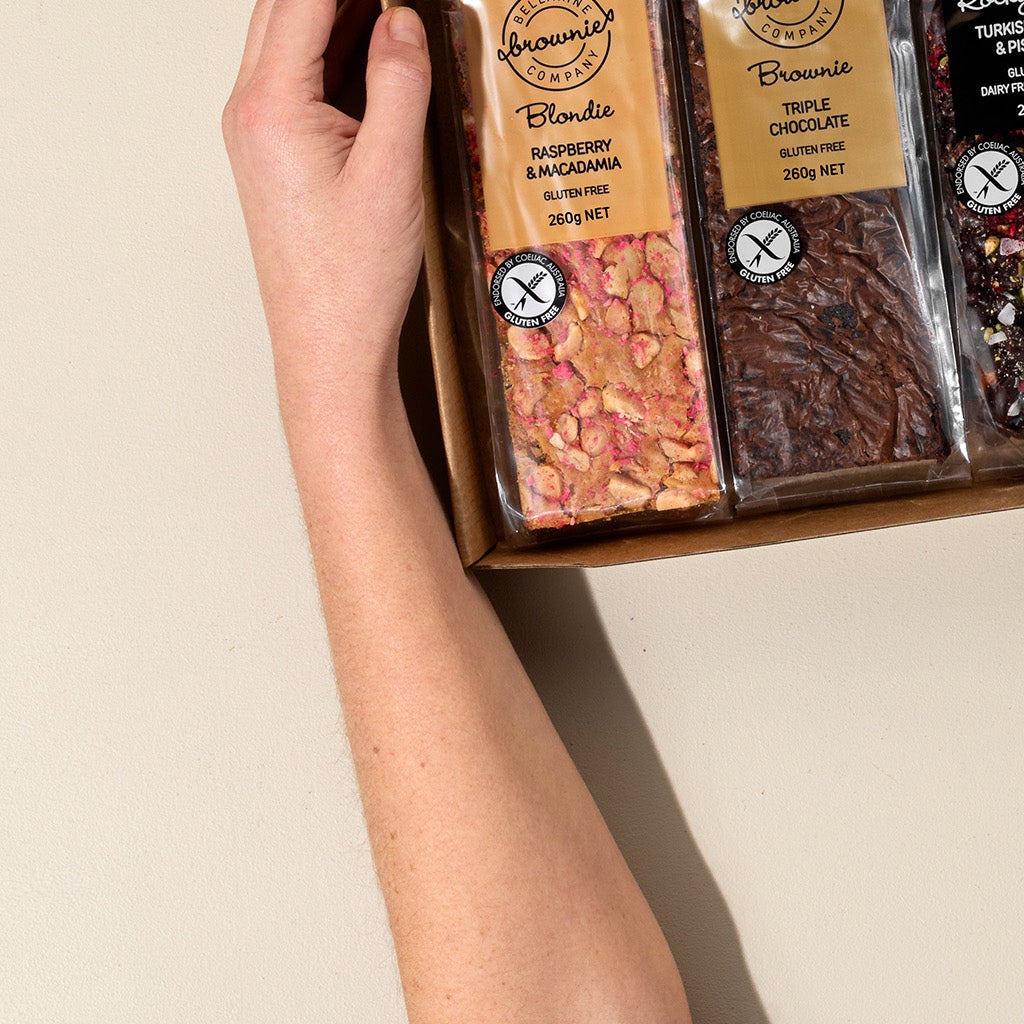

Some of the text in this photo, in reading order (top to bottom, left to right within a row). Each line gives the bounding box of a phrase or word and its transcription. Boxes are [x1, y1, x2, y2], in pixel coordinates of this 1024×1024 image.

[498, 8, 615, 61] brownie
[761, 7, 834, 40] COMPANY
[996, 42, 1006, 55] &
[526, 49, 599, 83] COMPANY
[747, 58, 853, 86] Brownie
[981, 84, 1010, 97] DAIRY
[515, 100, 615, 129] Blondie
[782, 98, 831, 116] TRIPLE
[769, 114, 850, 136] CHOCOLATE
[531, 139, 612, 161] RASPBERRY
[779, 141, 845, 158] GLUTEN FREE
[526, 156, 622, 180] & MACADAMIA
[783, 163, 845, 181] 260g NET
[955, 155, 969, 195] ENDORSED
[968, 147, 976, 156] BY
[978, 142, 1010, 152] COELIAC
[543, 184, 610, 201] GLUTEN FREE
[967, 193, 1021, 214] GLUTEN FREE
[548, 206, 610, 227] 260g NET
[728, 211, 800, 264] ENDORSED BY COELIAC AUSTRALIA
[493, 254, 565, 306] ENDORSED BY COELIAC AUSTRALIA
[740, 261, 794, 283] GLUTEN FREE
[504, 305, 559, 326] GLUTEN FREE
